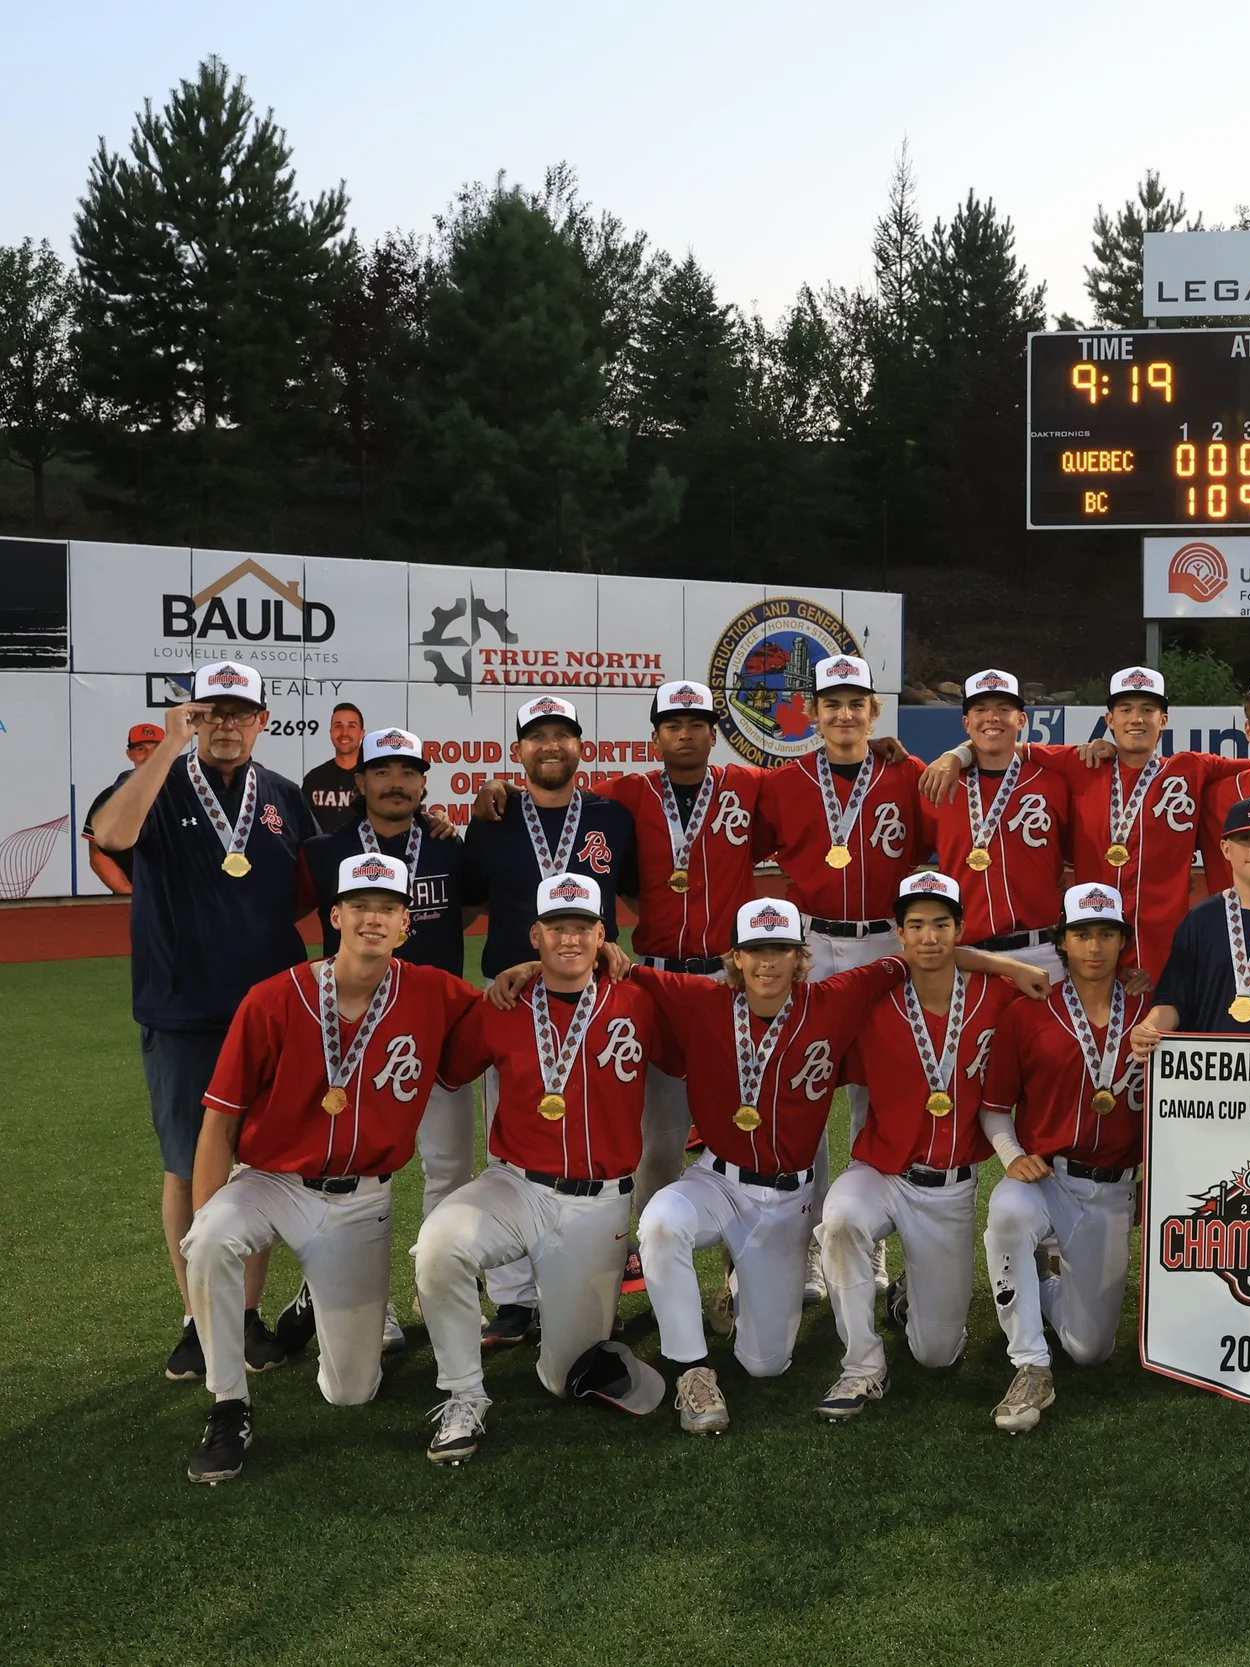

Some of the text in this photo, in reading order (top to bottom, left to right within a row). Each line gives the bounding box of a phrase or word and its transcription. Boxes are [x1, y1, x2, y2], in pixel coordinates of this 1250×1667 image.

[1078, 337, 1134, 360] TIME
[1072, 363, 1172, 403] 9:19
[1031, 430, 1091, 438] DAKTRONICS
[1179, 422, 1189, 442] 1
[1211, 421, 1223, 441] 2
[1062, 450, 1134, 473] QUEBEC
[1176, 443, 1195, 476] 0
[1208, 443, 1227, 476] 0
[1085, 491, 1108, 513] BC
[1208, 484, 1227, 518] 0
[162, 594, 335, 643] BAULD
[154, 648, 338, 663] LOUVELLE & ASSOCIATES
[732, 620, 842, 670] JUSTICE HONOR STREN
[479, 649, 662, 670] TRUE NORTH
[712, 602, 851, 720] CONSTRUCTION AND GENERAL
[264, 680, 342, 696] EALTY
[480, 669, 666, 688] AUTOMOTIVE
[423, 741, 502, 764] ROUD
[729, 730, 766, 765] UNION
[775, 742, 808, 753] January
[1159, 1099, 1215, 1119] CANADA
[1218, 1101, 1247, 1119] CUP
